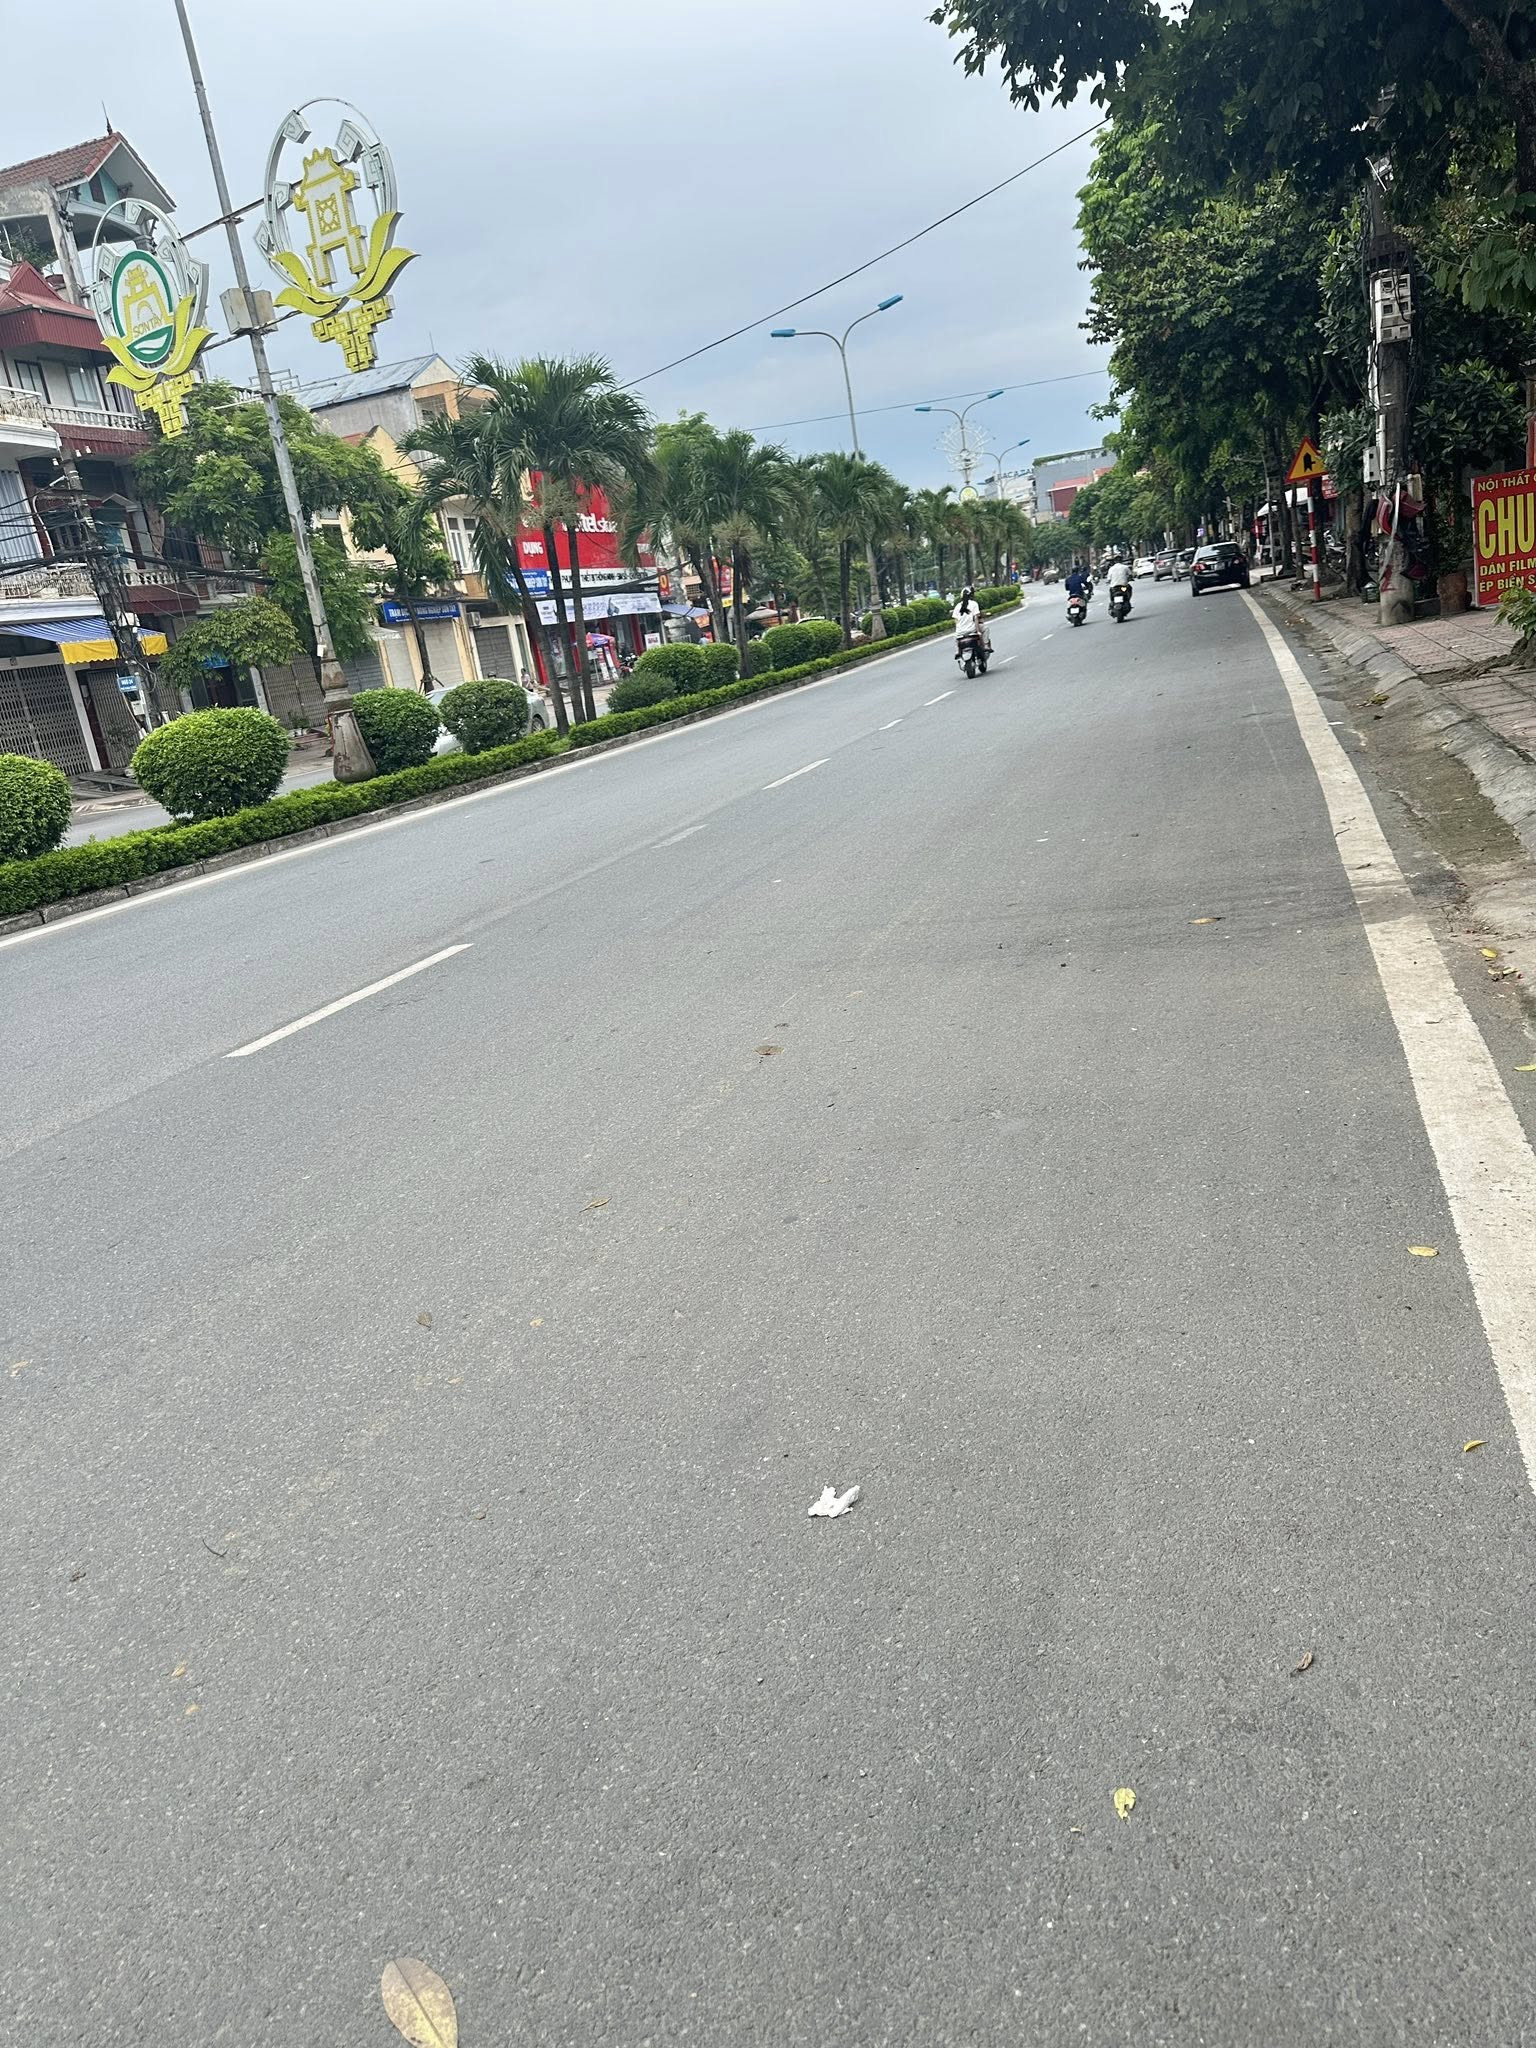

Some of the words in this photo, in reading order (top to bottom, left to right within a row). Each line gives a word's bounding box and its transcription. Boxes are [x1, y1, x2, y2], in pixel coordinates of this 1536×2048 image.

[1477, 478, 1499, 493] NỘI
[1502, 471, 1530, 488] THẤT
[1510, 557, 1536, 572] FILM
